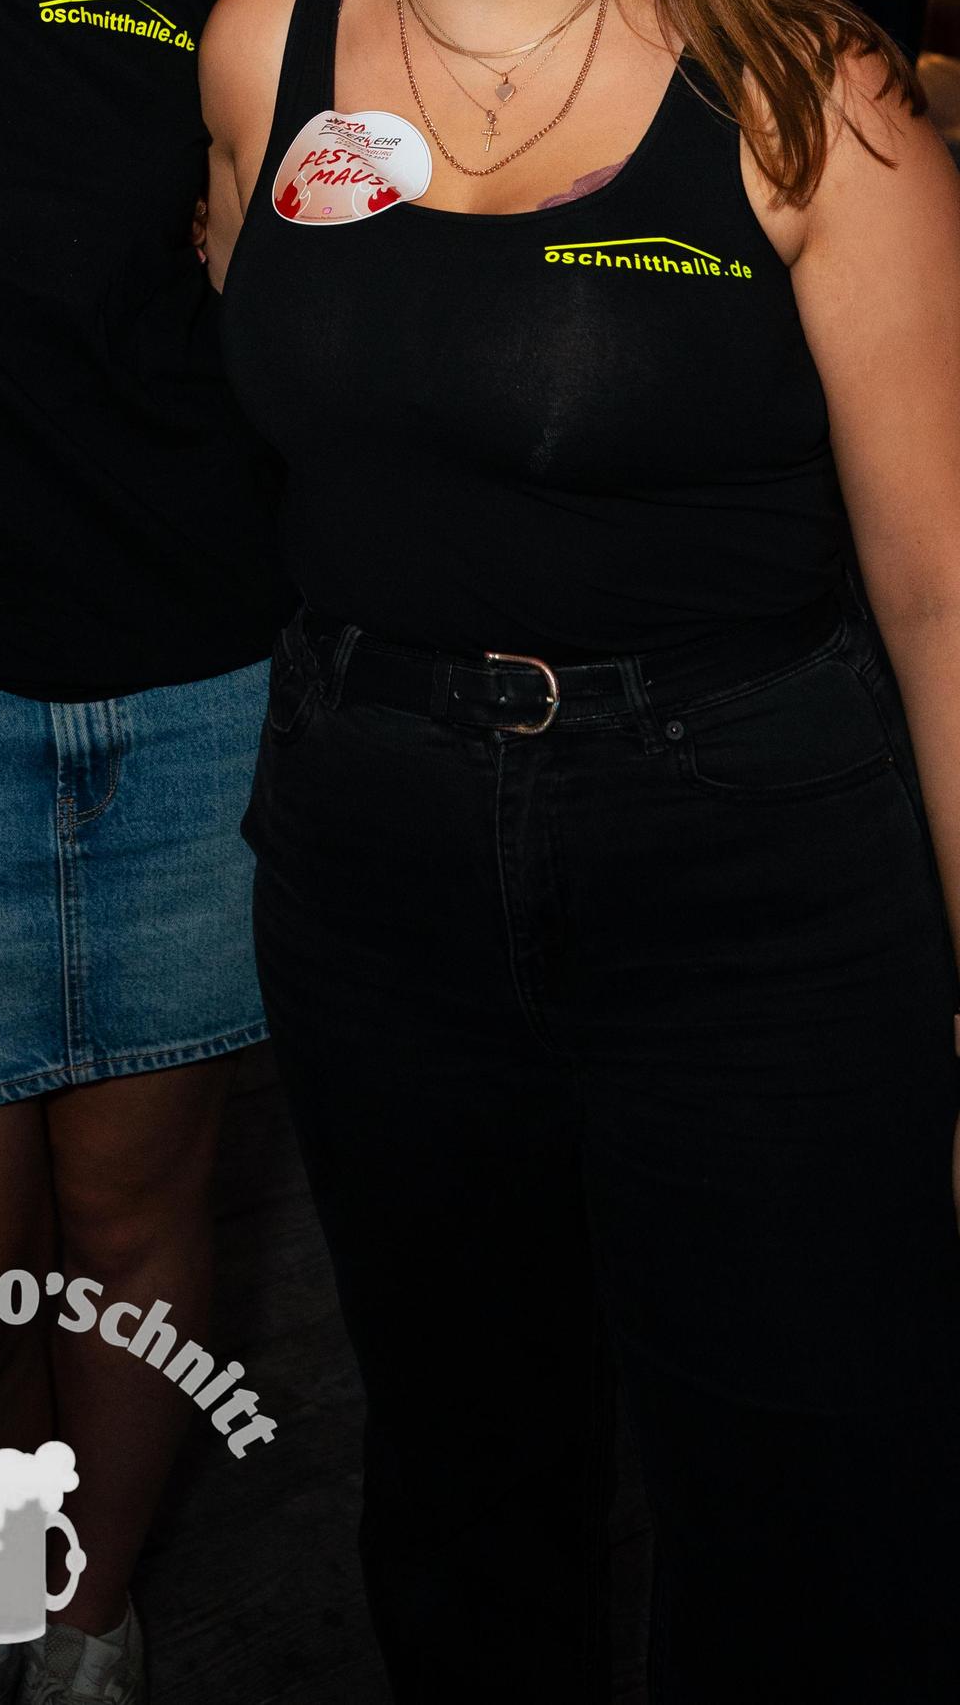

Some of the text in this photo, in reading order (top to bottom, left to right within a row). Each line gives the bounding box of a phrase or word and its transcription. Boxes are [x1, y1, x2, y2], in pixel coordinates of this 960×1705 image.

[40, 6, 195, 51] oschnitthalle.de
[306, 167, 390, 186] MAUS
[544, 250, 753, 280] oschnitthalle.de
